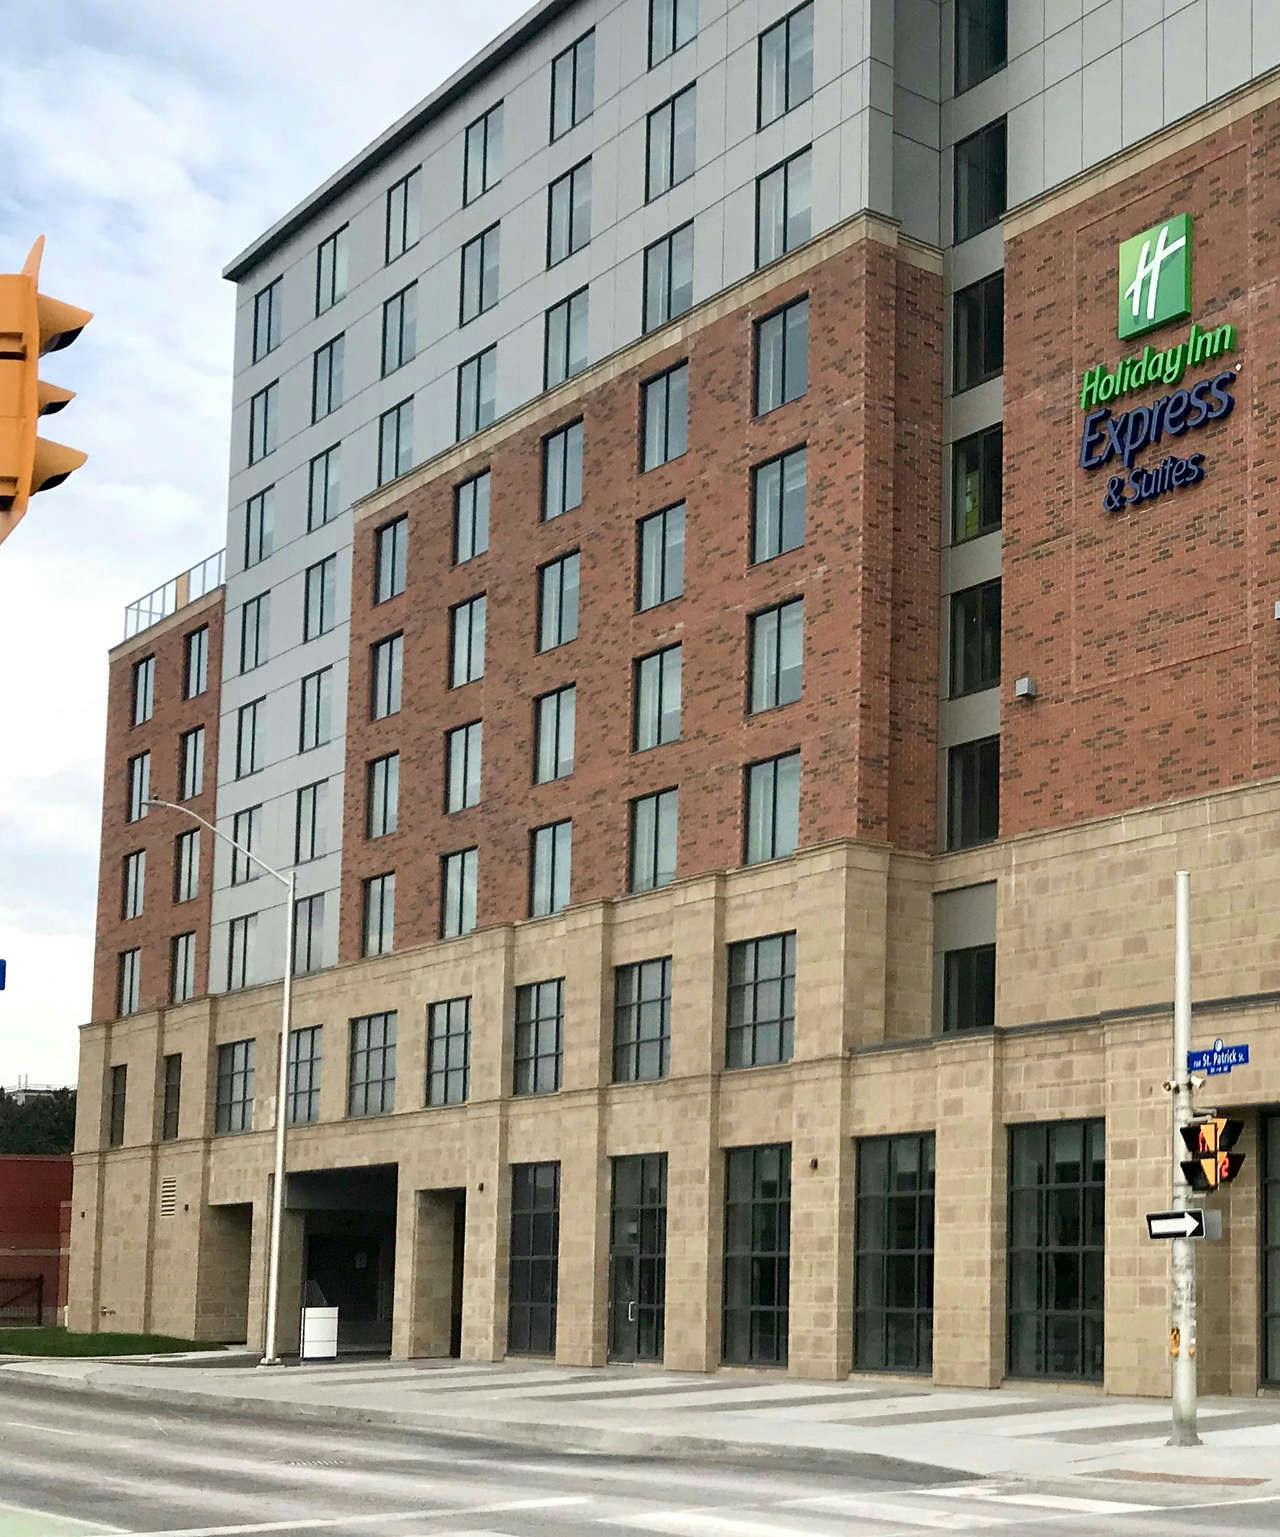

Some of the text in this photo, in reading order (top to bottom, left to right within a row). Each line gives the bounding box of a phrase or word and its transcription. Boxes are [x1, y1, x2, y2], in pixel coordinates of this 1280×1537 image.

[1080, 323, 1236, 410] Holiday Inn
[1079, 371, 1237, 469] Express
[1103, 453, 1206, 513] & Suites
[1213, 1048, 1237, 1066] Patrick
